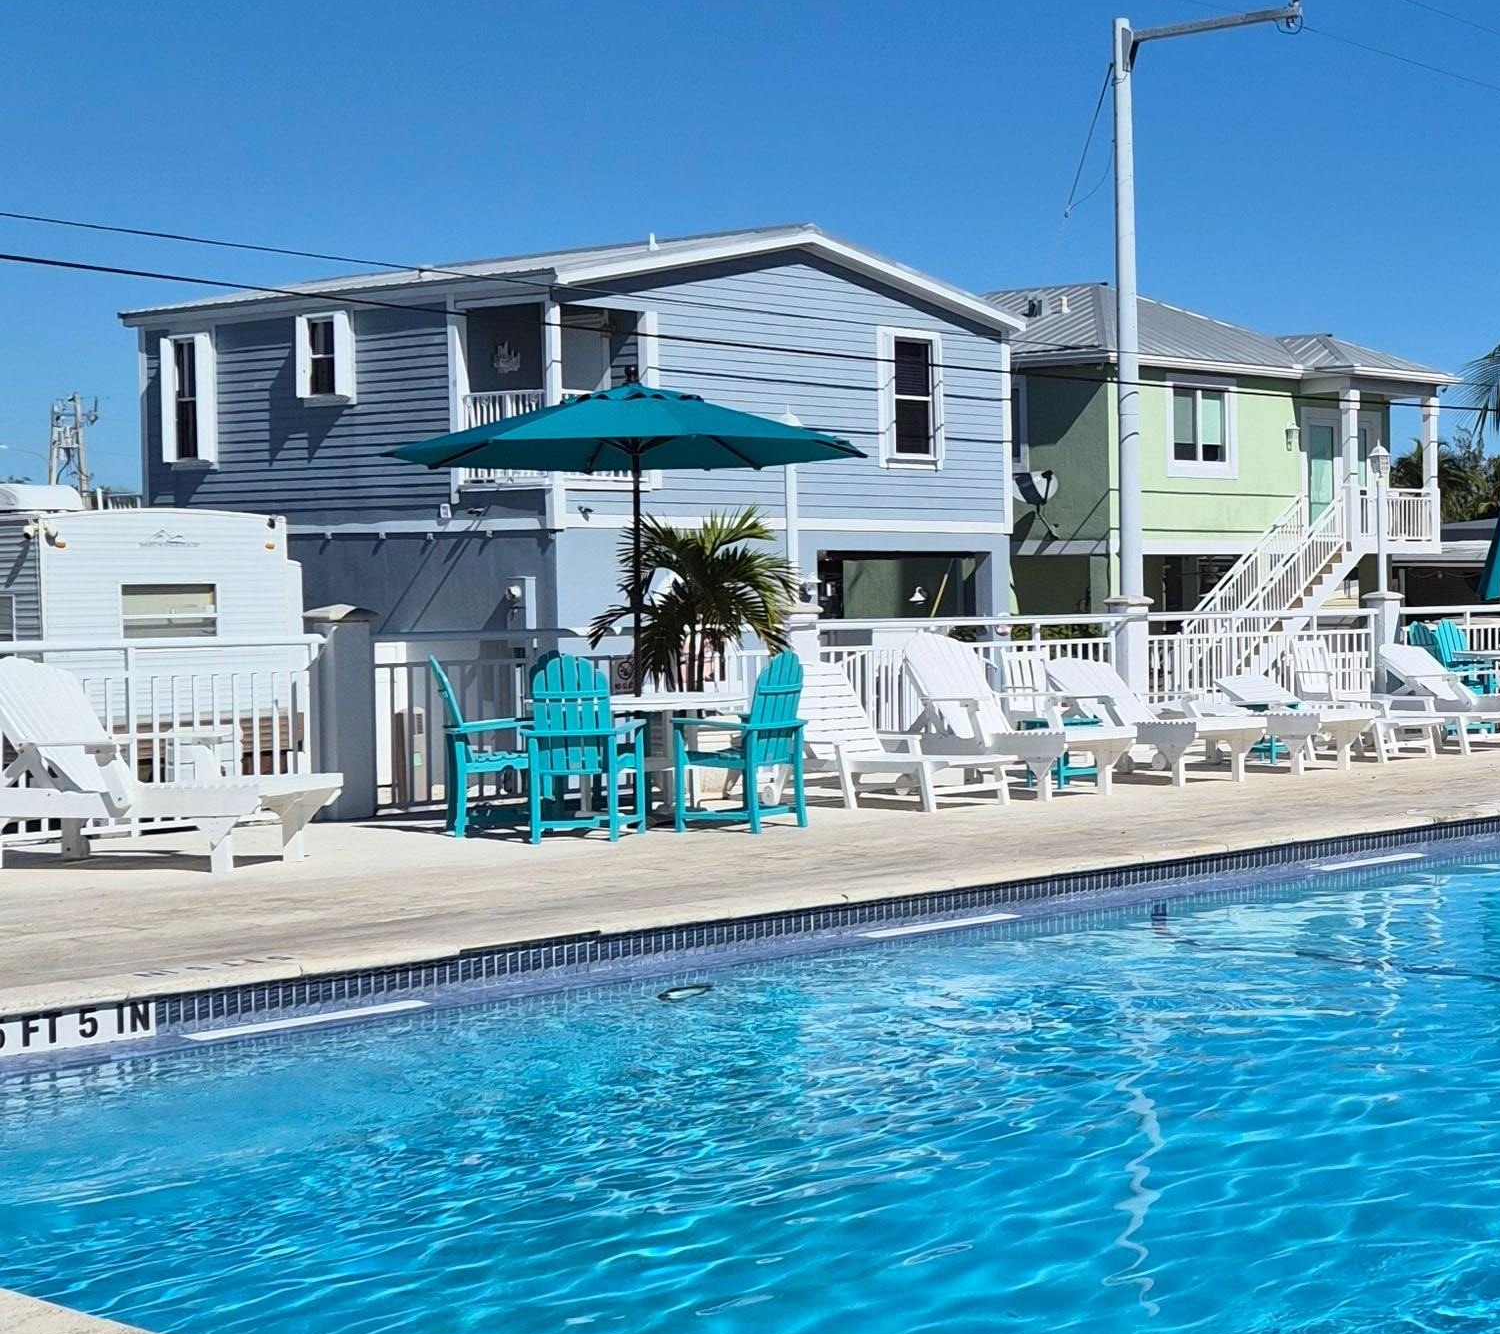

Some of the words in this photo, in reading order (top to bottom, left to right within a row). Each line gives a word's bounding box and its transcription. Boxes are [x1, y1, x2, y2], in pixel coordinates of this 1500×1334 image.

[21, 1011, 62, 1047] FT
[78, 1007, 99, 1038] 5
[116, 1000, 150, 1034] IN
